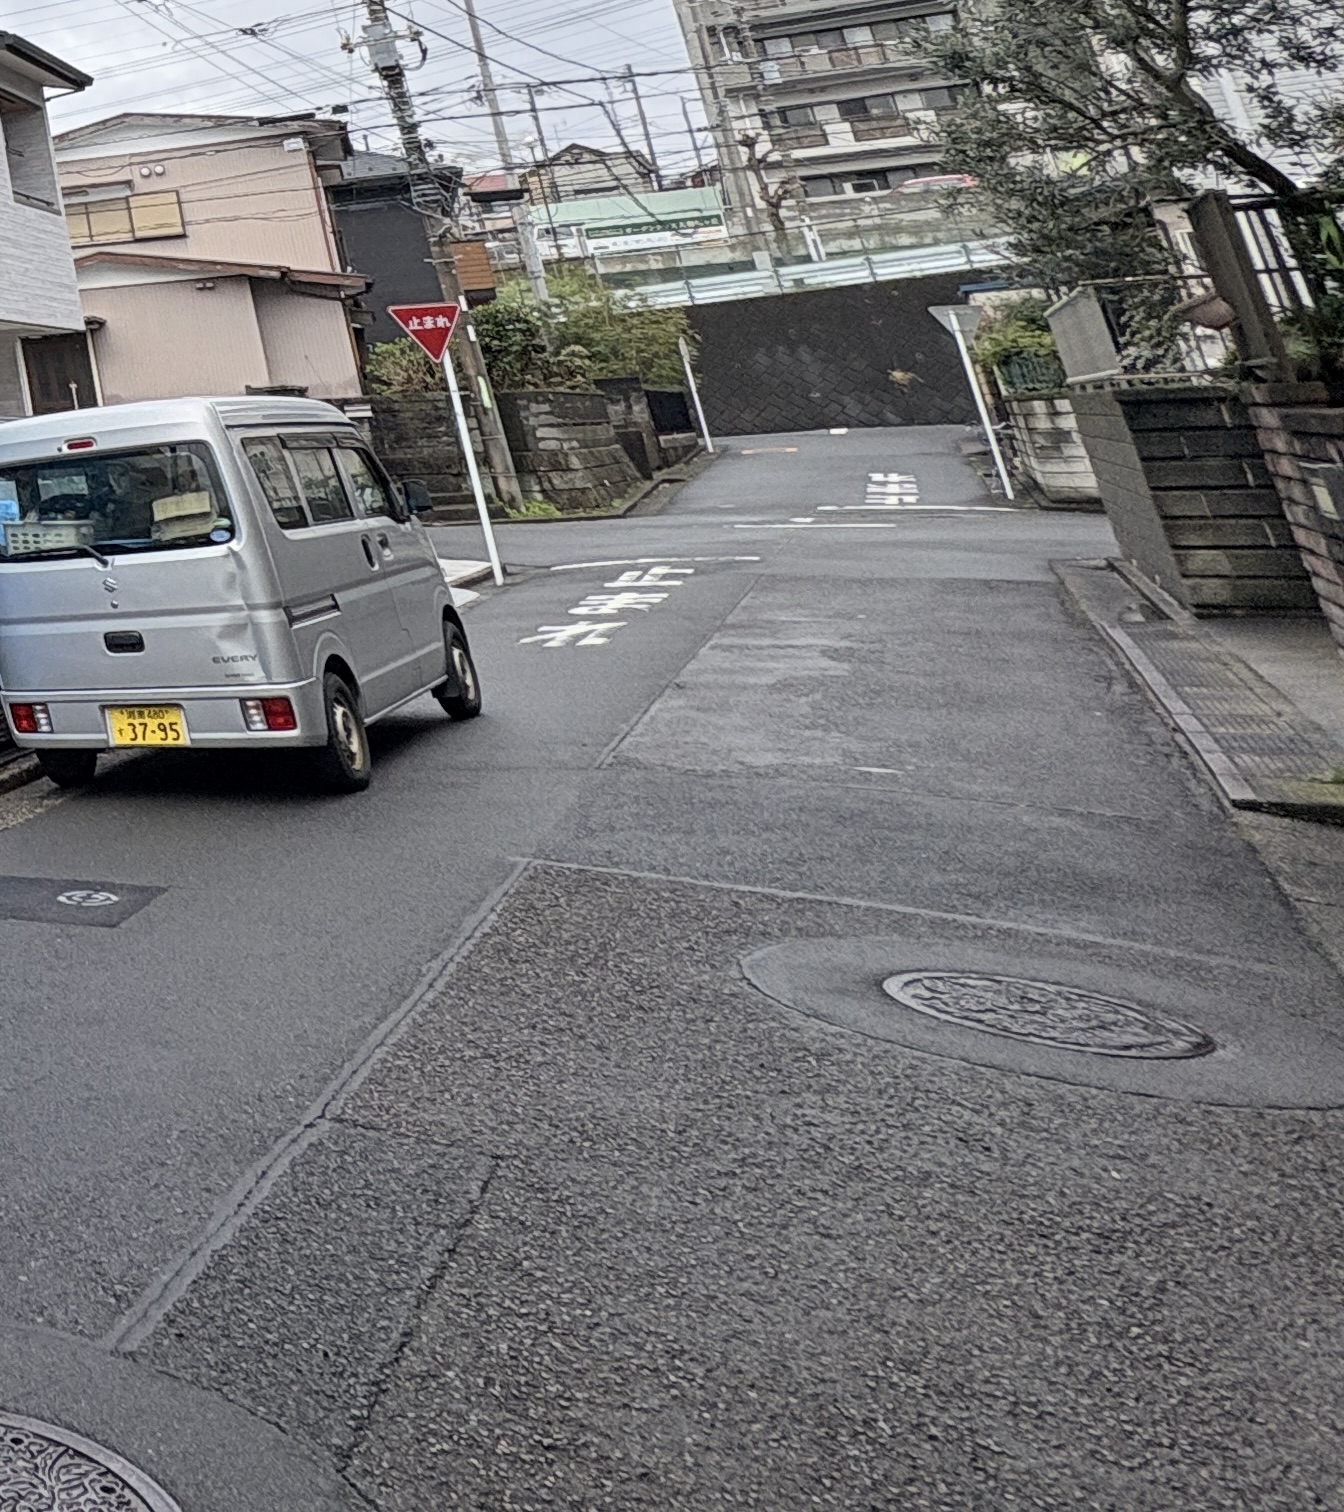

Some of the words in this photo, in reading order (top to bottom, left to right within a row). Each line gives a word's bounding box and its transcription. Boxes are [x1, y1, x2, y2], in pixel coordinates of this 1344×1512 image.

[408, 314, 452, 331] 止まれ
[212, 654, 258, 664] EVERY
